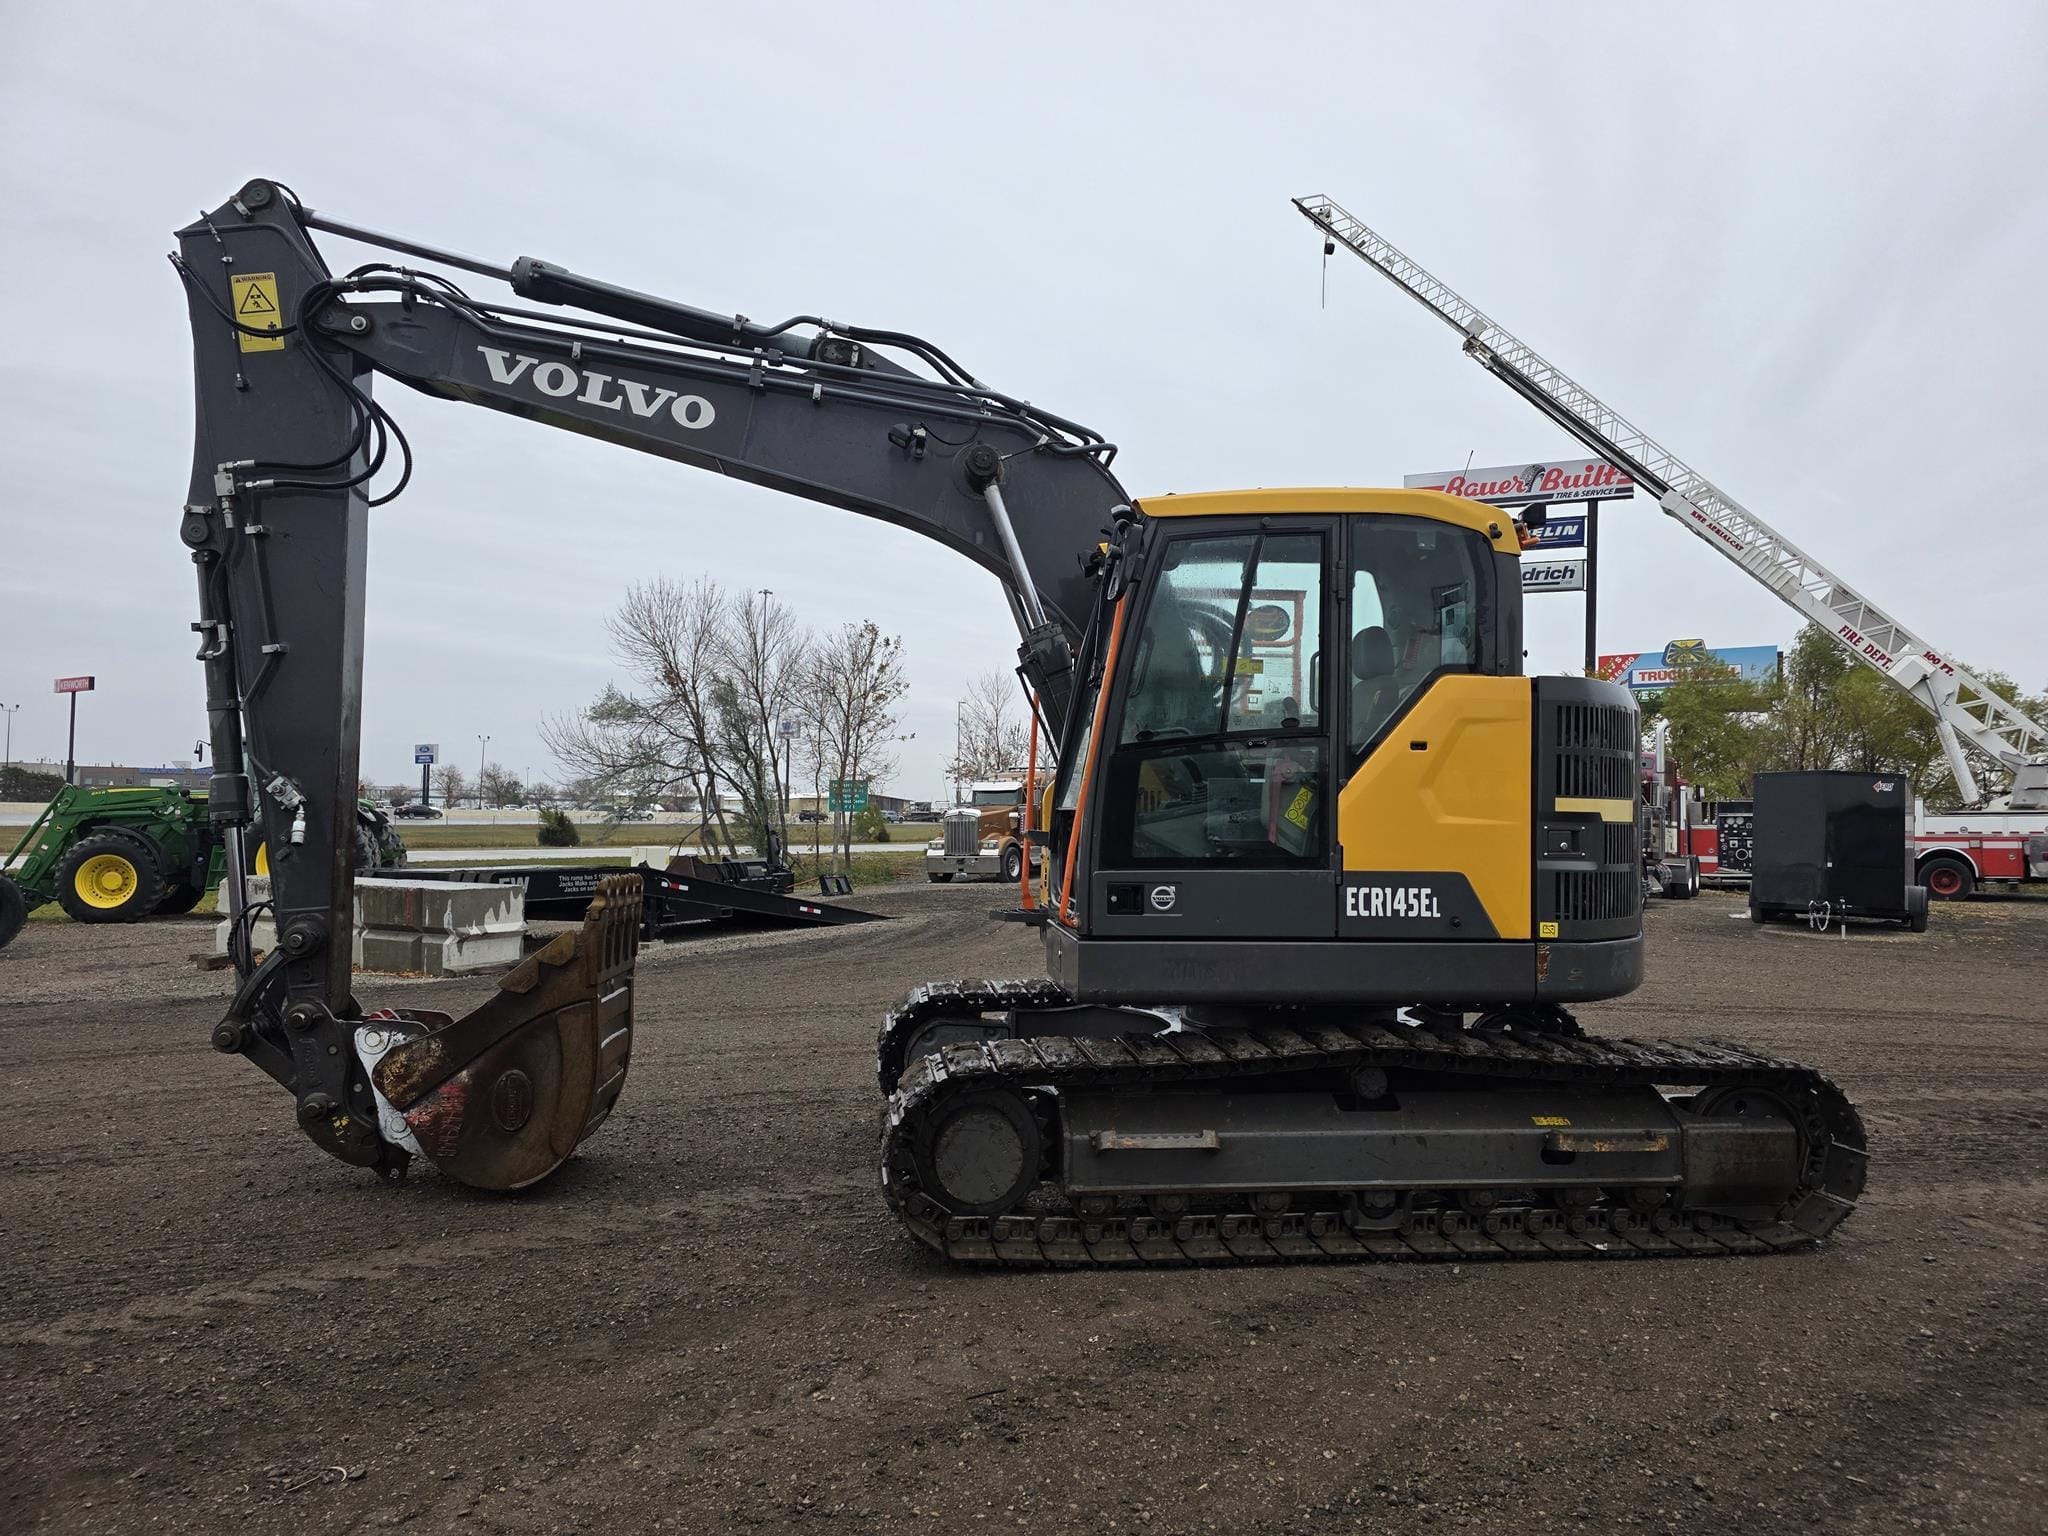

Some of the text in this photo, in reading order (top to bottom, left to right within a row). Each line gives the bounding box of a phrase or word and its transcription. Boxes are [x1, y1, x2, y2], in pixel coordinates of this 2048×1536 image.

[241, 274, 273, 282] WARNING
[477, 345, 716, 429] VOLVO
[1445, 464, 1620, 497] Bauer Built
[1556, 488, 1614, 499] TIRE & SERVICE
[1522, 565, 1575, 581] drich
[1837, 624, 1894, 670] FIRE DEPT.
[1923, 651, 1941, 666] 100
[1615, 669, 1623, 677] to
